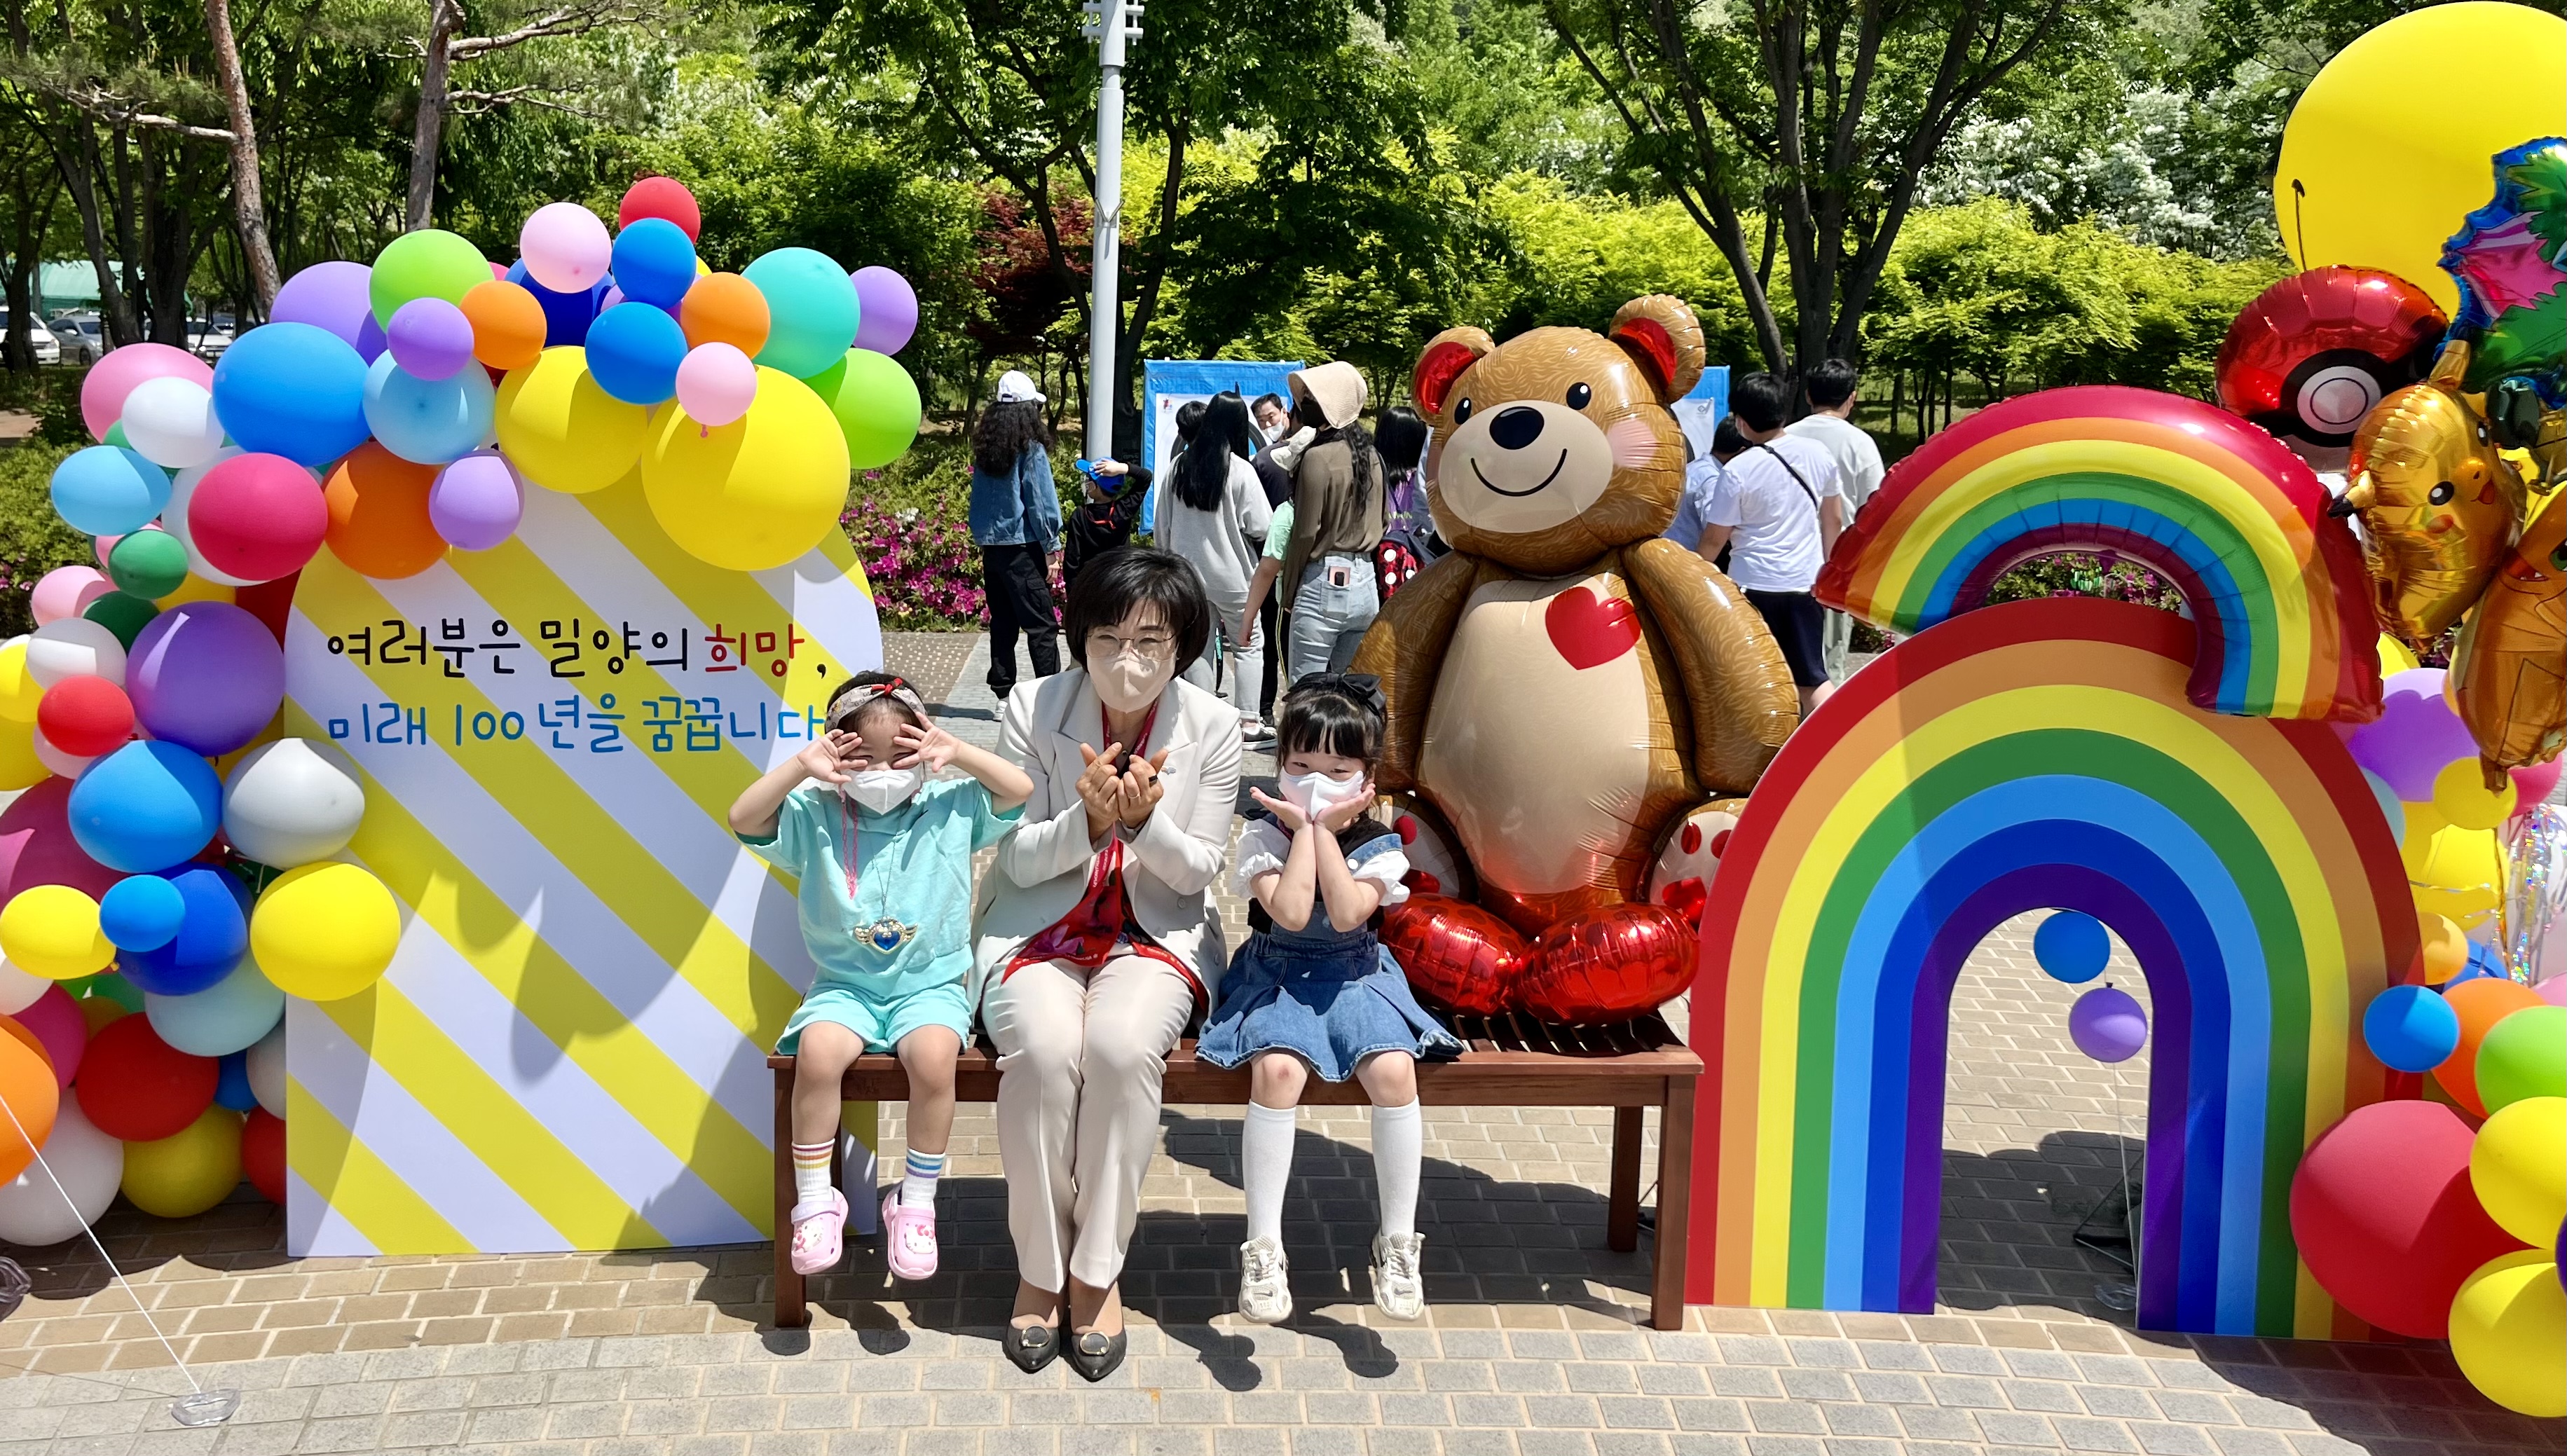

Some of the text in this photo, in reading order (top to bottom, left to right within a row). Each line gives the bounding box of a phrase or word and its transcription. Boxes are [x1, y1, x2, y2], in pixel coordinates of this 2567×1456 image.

[327, 619, 826, 678] 여러분은 밀양의 희망,
[329, 702, 426, 746] 미래
[642, 696, 826, 753] 꿈꿉니다
